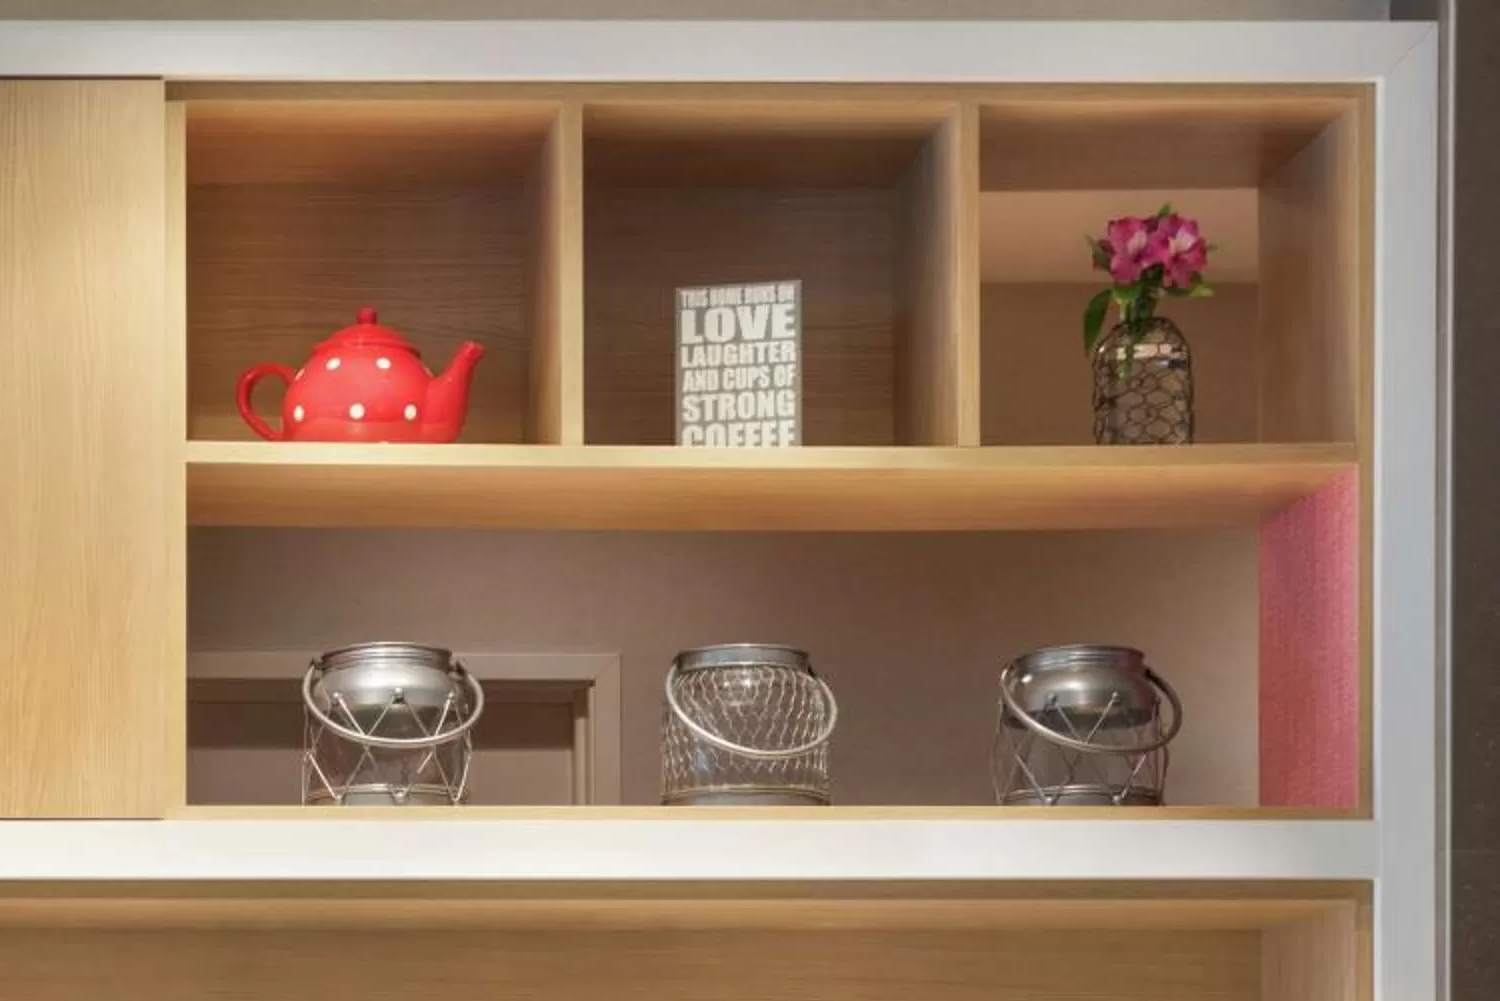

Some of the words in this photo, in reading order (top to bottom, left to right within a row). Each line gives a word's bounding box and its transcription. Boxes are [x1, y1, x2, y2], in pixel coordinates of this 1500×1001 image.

[681, 303, 797, 344] LOVE
[680, 340, 797, 369] LAUGHTER
[682, 369, 719, 392] AND
[722, 365, 771, 390] CUPS
[773, 363, 797, 387] OF
[682, 389, 797, 422] STRONG
[681, 419, 796, 447] COFFEE
